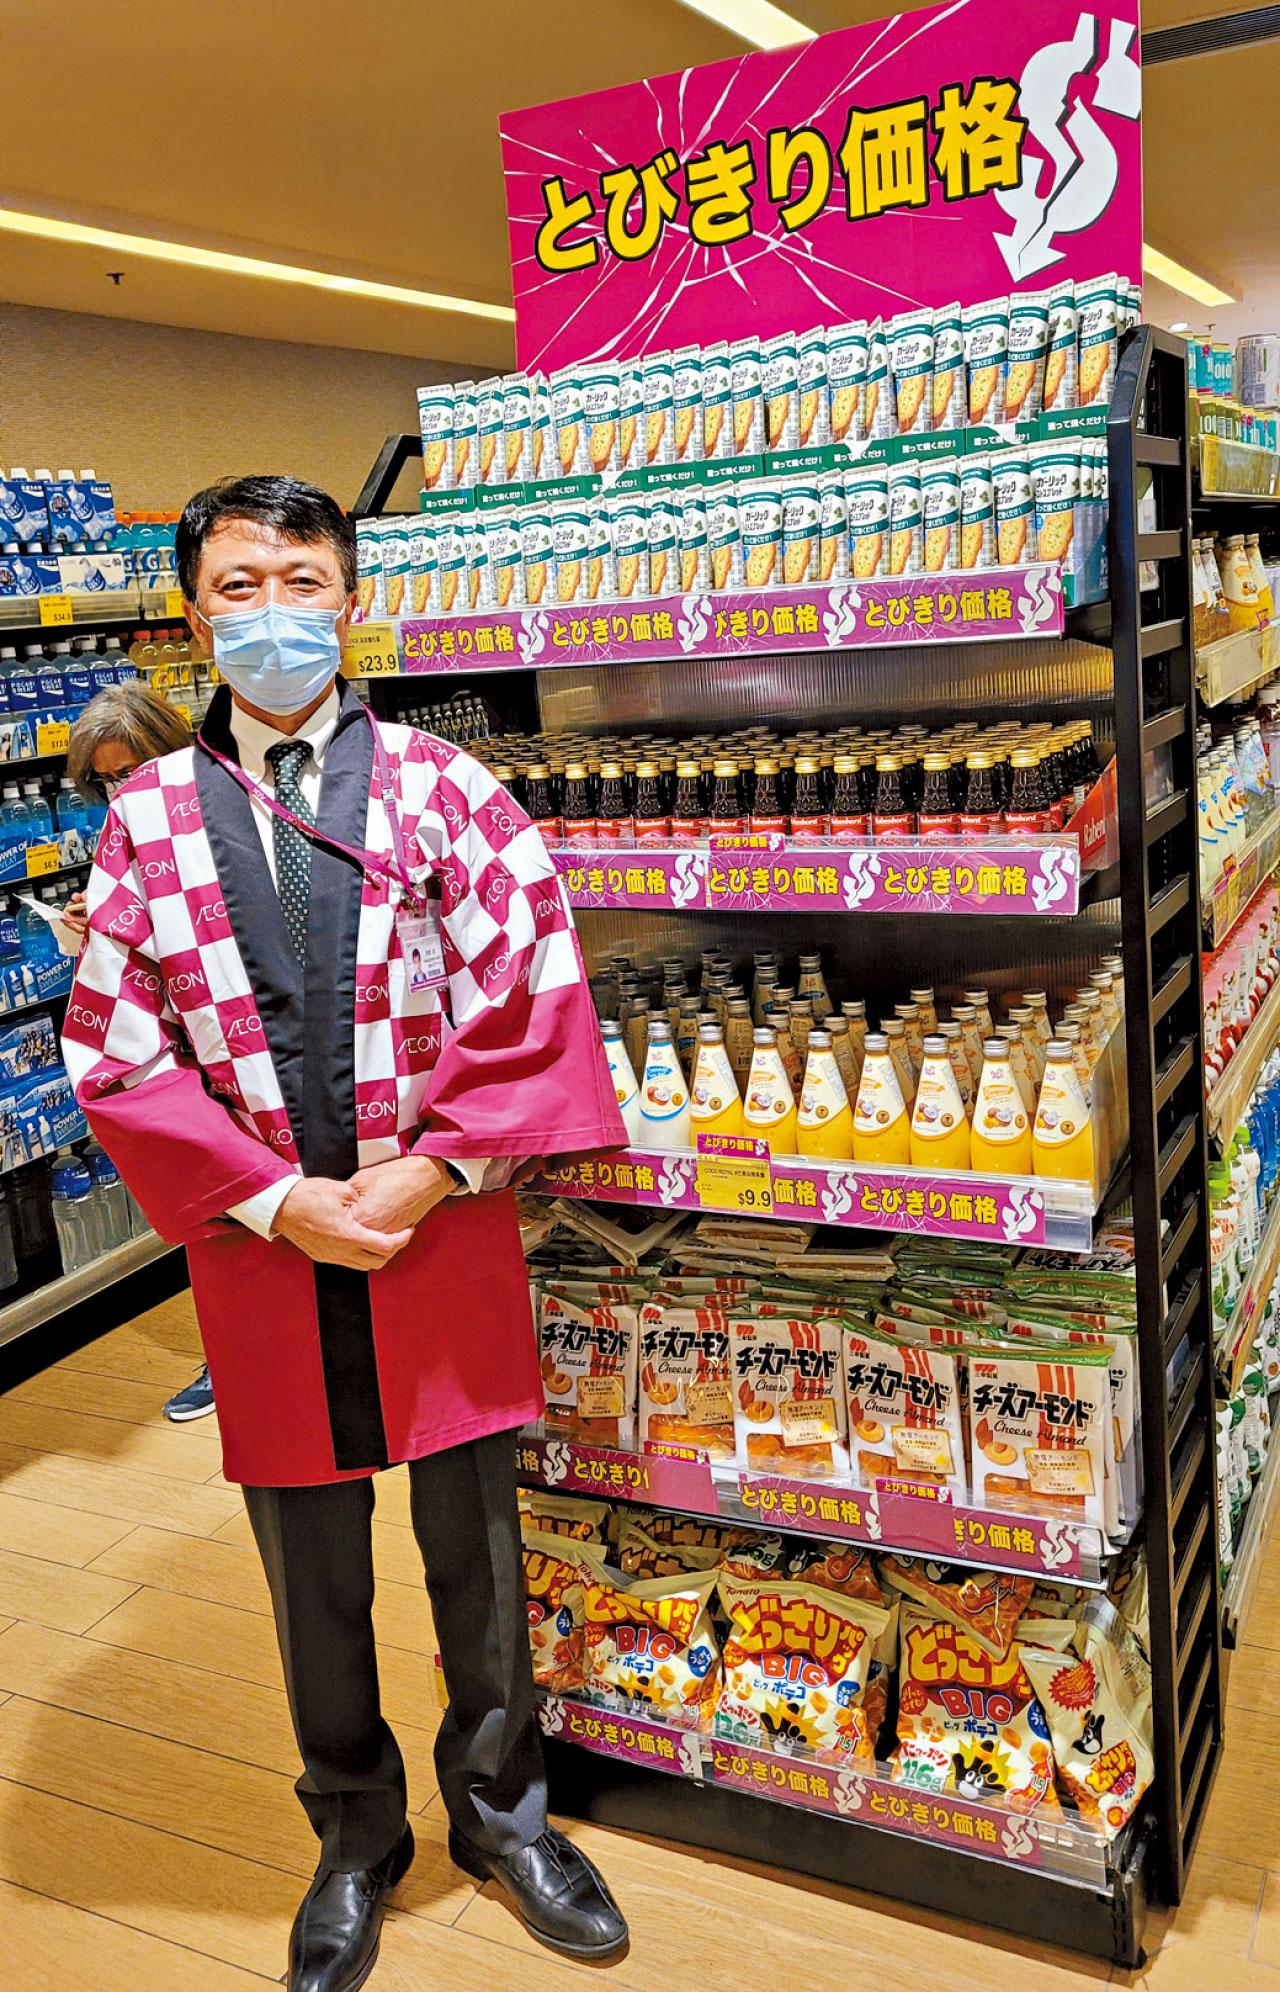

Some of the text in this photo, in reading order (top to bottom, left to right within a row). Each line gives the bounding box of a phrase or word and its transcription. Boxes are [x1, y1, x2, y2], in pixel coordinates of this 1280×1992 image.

[536, 75, 1028, 273] とびきり価格
[864, 587, 1012, 628] とびきり価格
[402, 624, 514, 657] とびきり価格
[552, 611, 674, 648] とびきり価格
[358, 654, 397, 673] $23.9
[716, 835, 767, 848] とびきり価格
[563, 866, 667, 895] びきり価格
[710, 866, 839, 895] とびきり価格
[883, 865, 1027, 896] とびきり価格
[37, 965, 63, 985] POWER
[704, 1136, 755, 1152] とびきり価格
[738, 1189, 771, 1207] $9.9
[859, 1186, 999, 1226] とびきり価格
[541, 1318, 632, 1357] チーズアーモンド
[557, 1353, 587, 1367] Cheese
[658, 1361, 693, 1374] Cheese
[736, 1342, 837, 1378] チーズアーモンド
[847, 1361, 951, 1410] チーズアーモンド
[864, 1398, 901, 1416] Cheese
[973, 1382, 1094, 1428] チーズアーモンド
[993, 1420, 1087, 1446] Cheese Almond
[740, 1483, 861, 1527] とびきり価格
[883, 1481, 936, 1500] とびきり価格
[615, 1625, 676, 1662] BIG
[729, 1597, 840, 1659] どっさり
[623, 1655, 654, 1674] ポテコ
[760, 1654, 829, 1688] BIG
[772, 1681, 806, 1700] ポテコ
[939, 1688, 1014, 1724] BIG
[569, 1713, 676, 1760] とびきり価格
[963, 1719, 998, 1739] ポテコ
[714, 1751, 830, 1801] とびきり価格
[870, 1791, 998, 1844] とびきり価格
